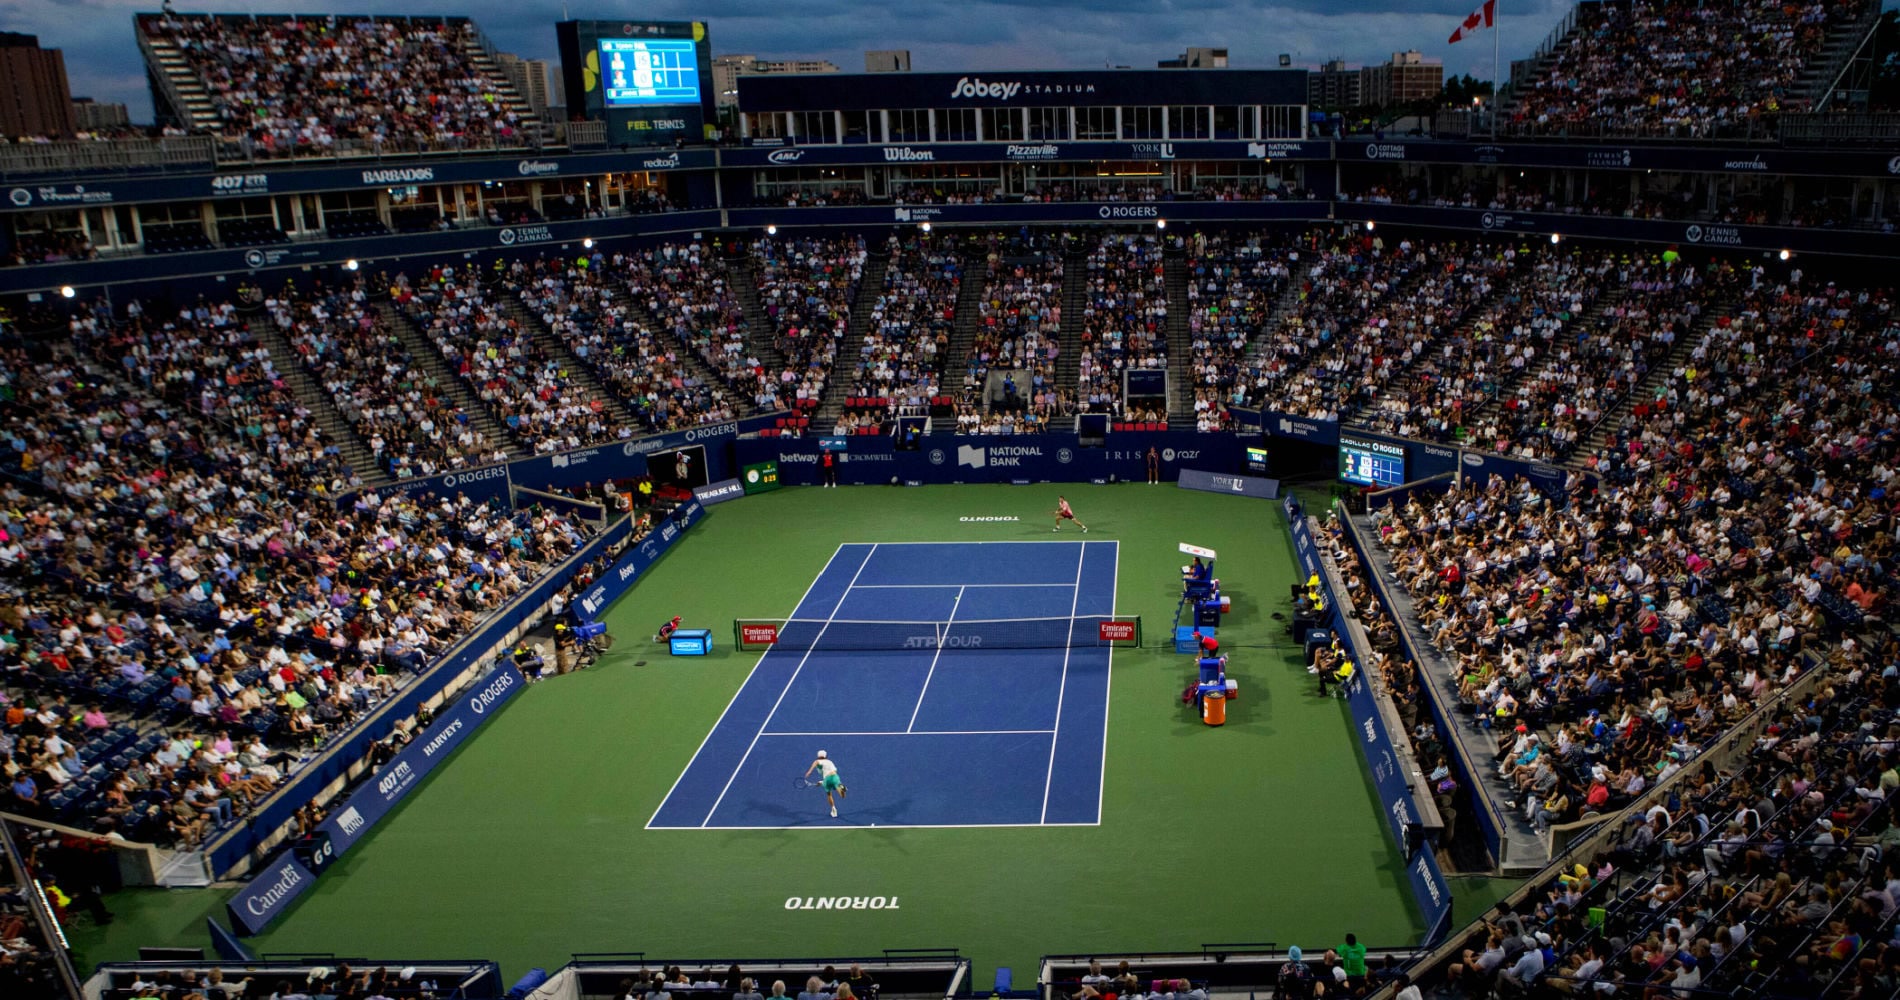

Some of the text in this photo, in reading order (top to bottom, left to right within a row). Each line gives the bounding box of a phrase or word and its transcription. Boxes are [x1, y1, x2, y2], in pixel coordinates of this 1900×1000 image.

[951, 77, 1095, 100] Sobeys STADIUM
[627, 119, 686, 131] FEEL TENNIS
[1006, 144, 1059, 155] Pizzaville
[1131, 143, 1160, 152] YORK
[1268, 143, 1302, 151] NATIONAL
[773, 151, 801, 161] AMJ
[883, 147, 934, 161] Wilson
[361, 167, 435, 184] BARBADOS
[211, 176, 244, 189] 407
[1113, 206, 1158, 217] ROGERS
[517, 226, 548, 235] TENNIS
[1704, 226, 1739, 236] TENNIS
[517, 232, 553, 243] CANADA
[1703, 235, 1742, 245] CANADA
[697, 423, 735, 438] ROGERS
[1293, 421, 1318, 432] NATIONAL
[1293, 428, 1308, 436] BANK
[989, 446, 1043, 456] NATIONAL
[1340, 438, 1404, 455] CADILLAC ROGERS
[1425, 446, 1453, 458] beneva
[570, 449, 599, 459] NATIONAL
[779, 453, 820, 464] betway
[849, 453, 895, 461] CROMWELL
[1177, 450, 1200, 459] razr
[570, 456, 588, 465] BANK
[989, 457, 1021, 467] BANK
[459, 466, 506, 485] ROGERS
[1212, 476, 1232, 485] YORK
[697, 484, 742, 501] TREASURE HILL
[1101, 624, 1133, 633] Emirates
[903, 636, 939, 648] ATP
[480, 671, 514, 706] ROGERS
[423, 718, 463, 757] HARVEY'S
[379, 771, 398, 794] 407
[343, 815, 365, 836] KIND
[247, 864, 302, 916] Canada
[784, 896, 900, 910] TORONTO
